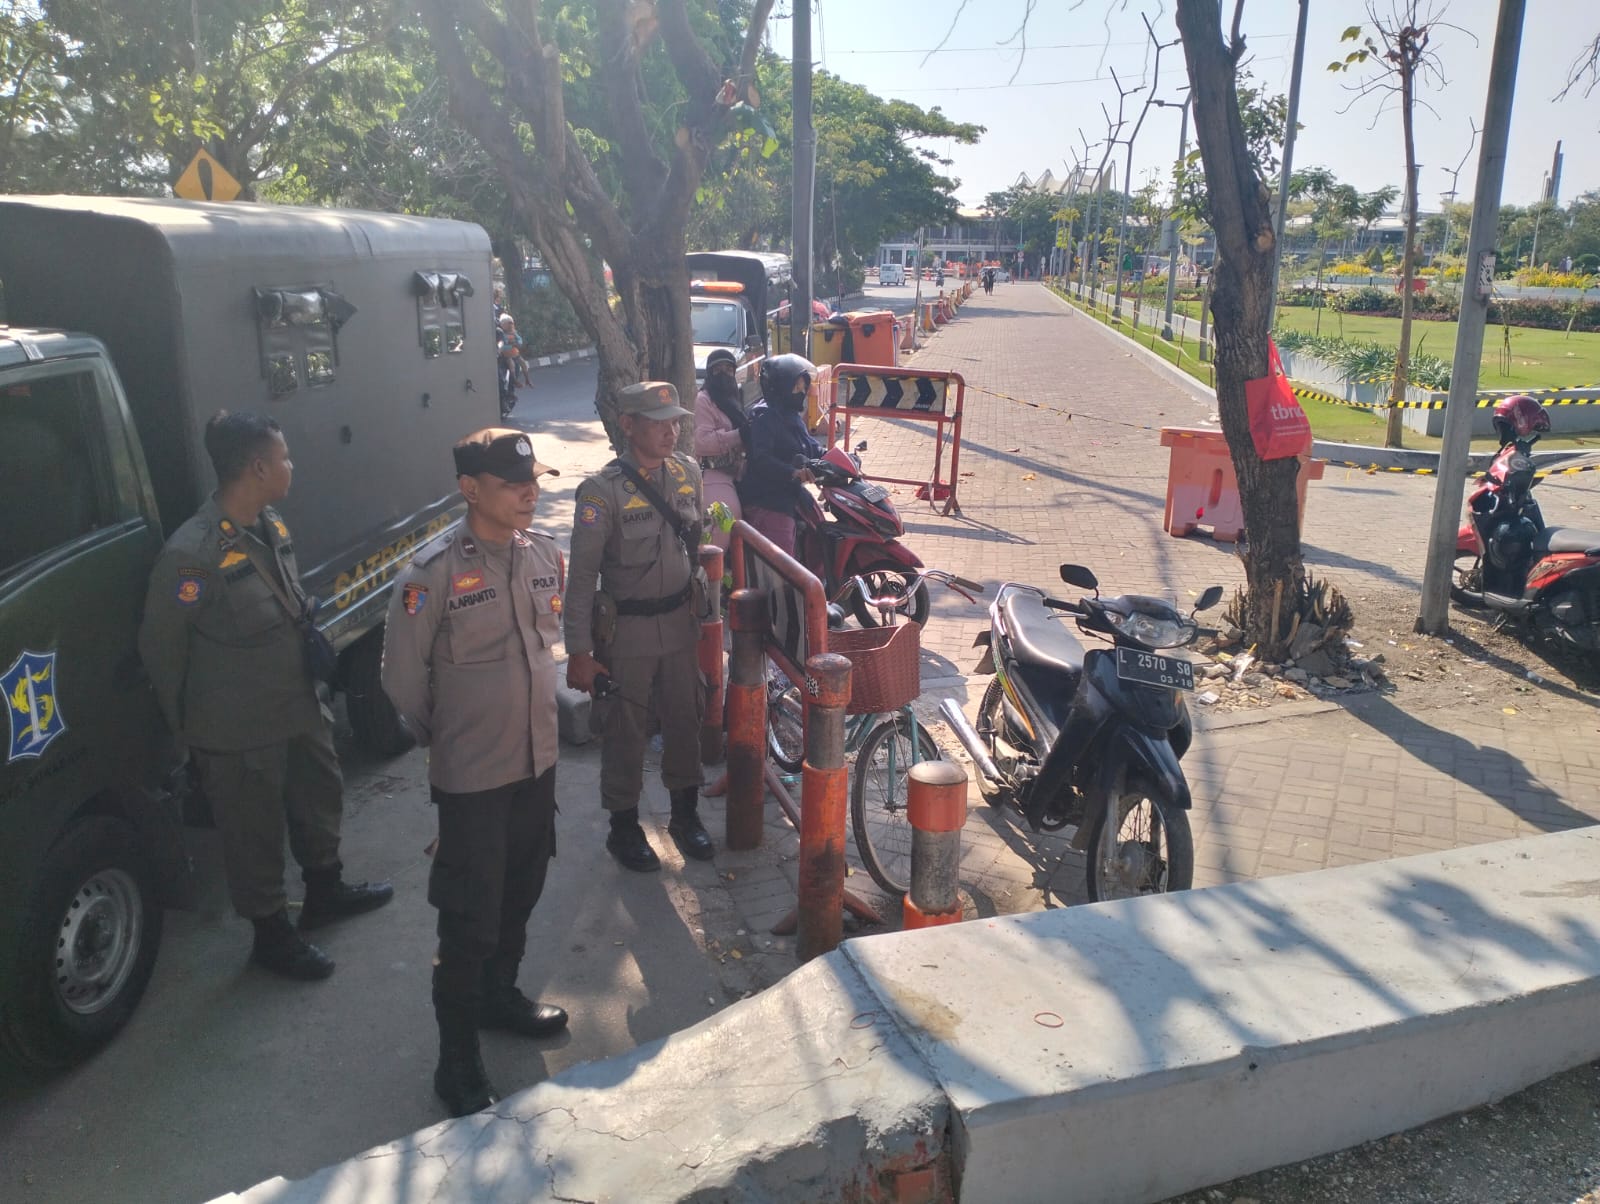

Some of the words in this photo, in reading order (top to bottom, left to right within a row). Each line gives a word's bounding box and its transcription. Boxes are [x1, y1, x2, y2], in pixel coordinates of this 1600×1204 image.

[622, 511, 653, 523] SAKUR
[448, 588, 497, 611] A.ARIANTO
[1119, 650, 1127, 663] L
[1138, 654, 1167, 671] 2570
